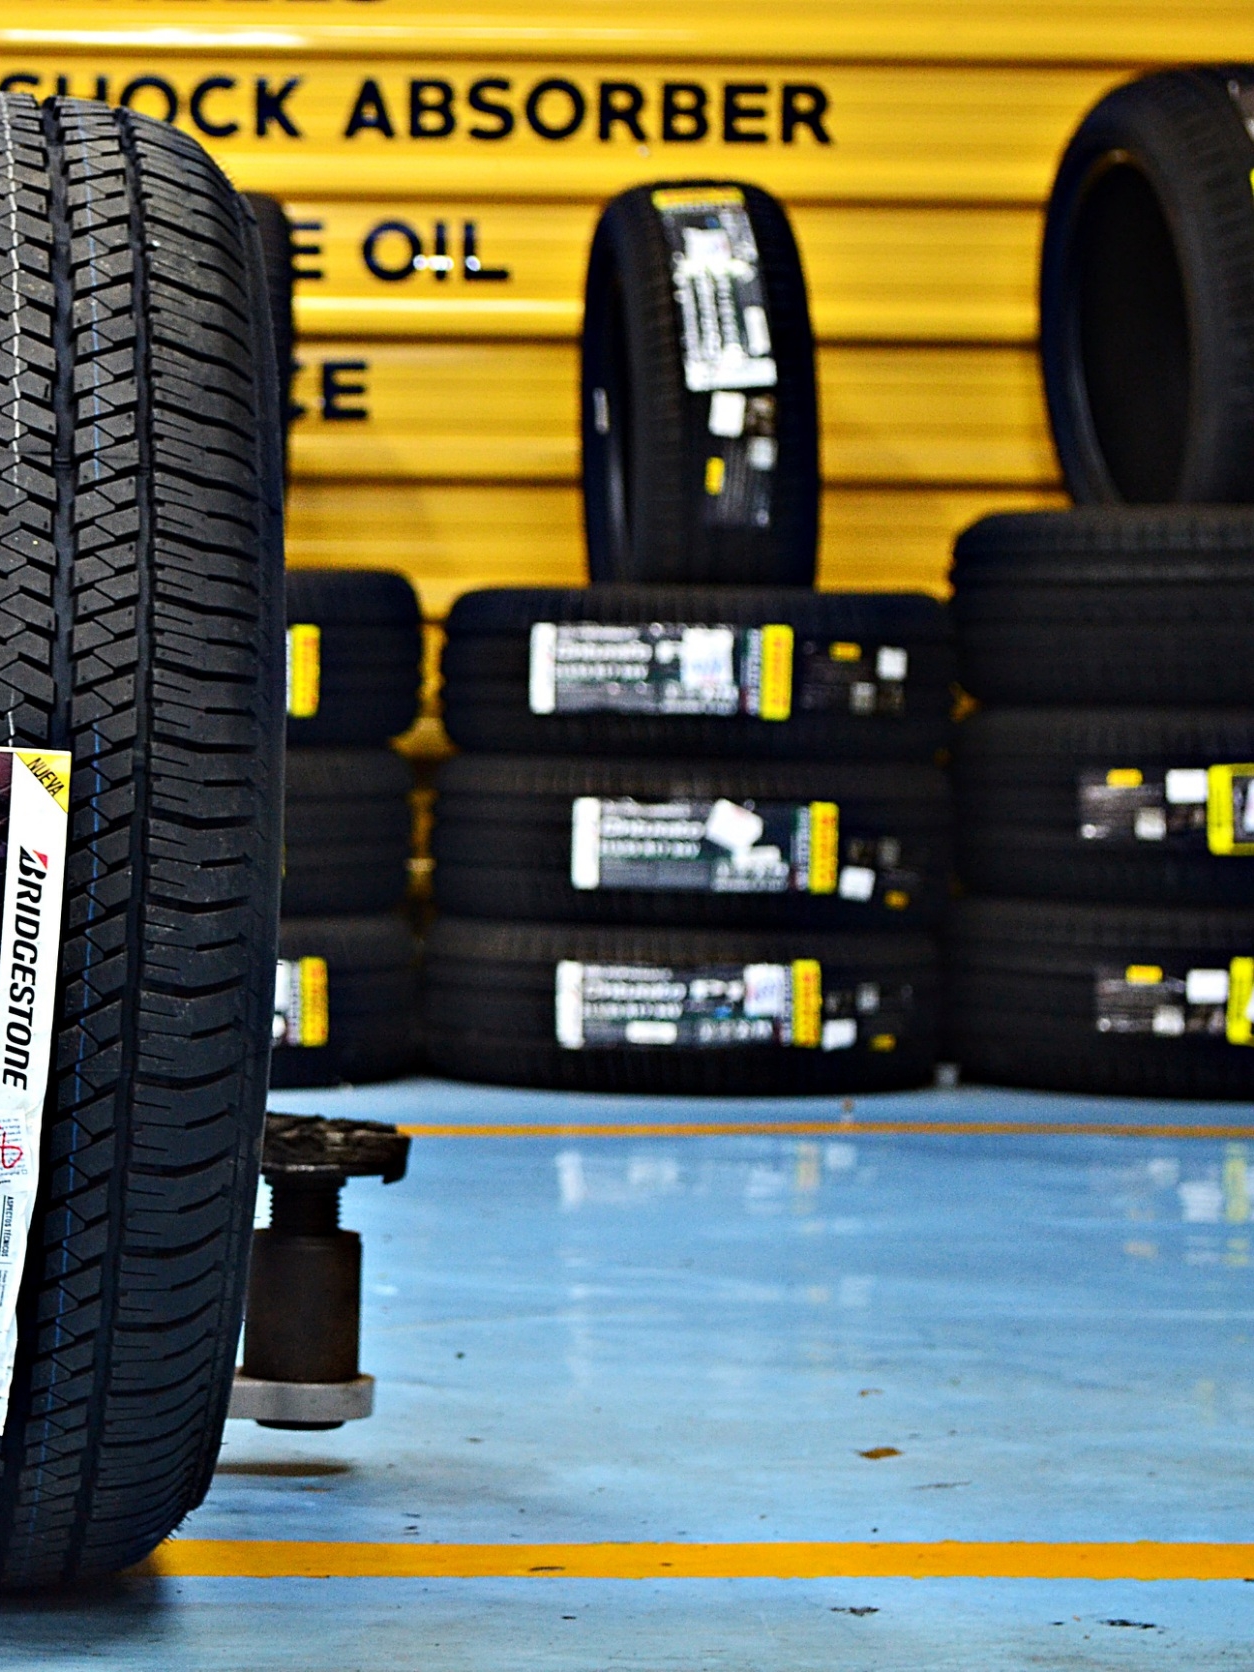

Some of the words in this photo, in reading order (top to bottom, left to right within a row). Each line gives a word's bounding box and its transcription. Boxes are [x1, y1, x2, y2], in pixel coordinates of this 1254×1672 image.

[342, 76, 832, 145] ABSORBER
[362, 220, 510, 281] OIL
[26, 757, 65, 798] NUEVA
[2, 845, 48, 1091] BRIDGESTONE
